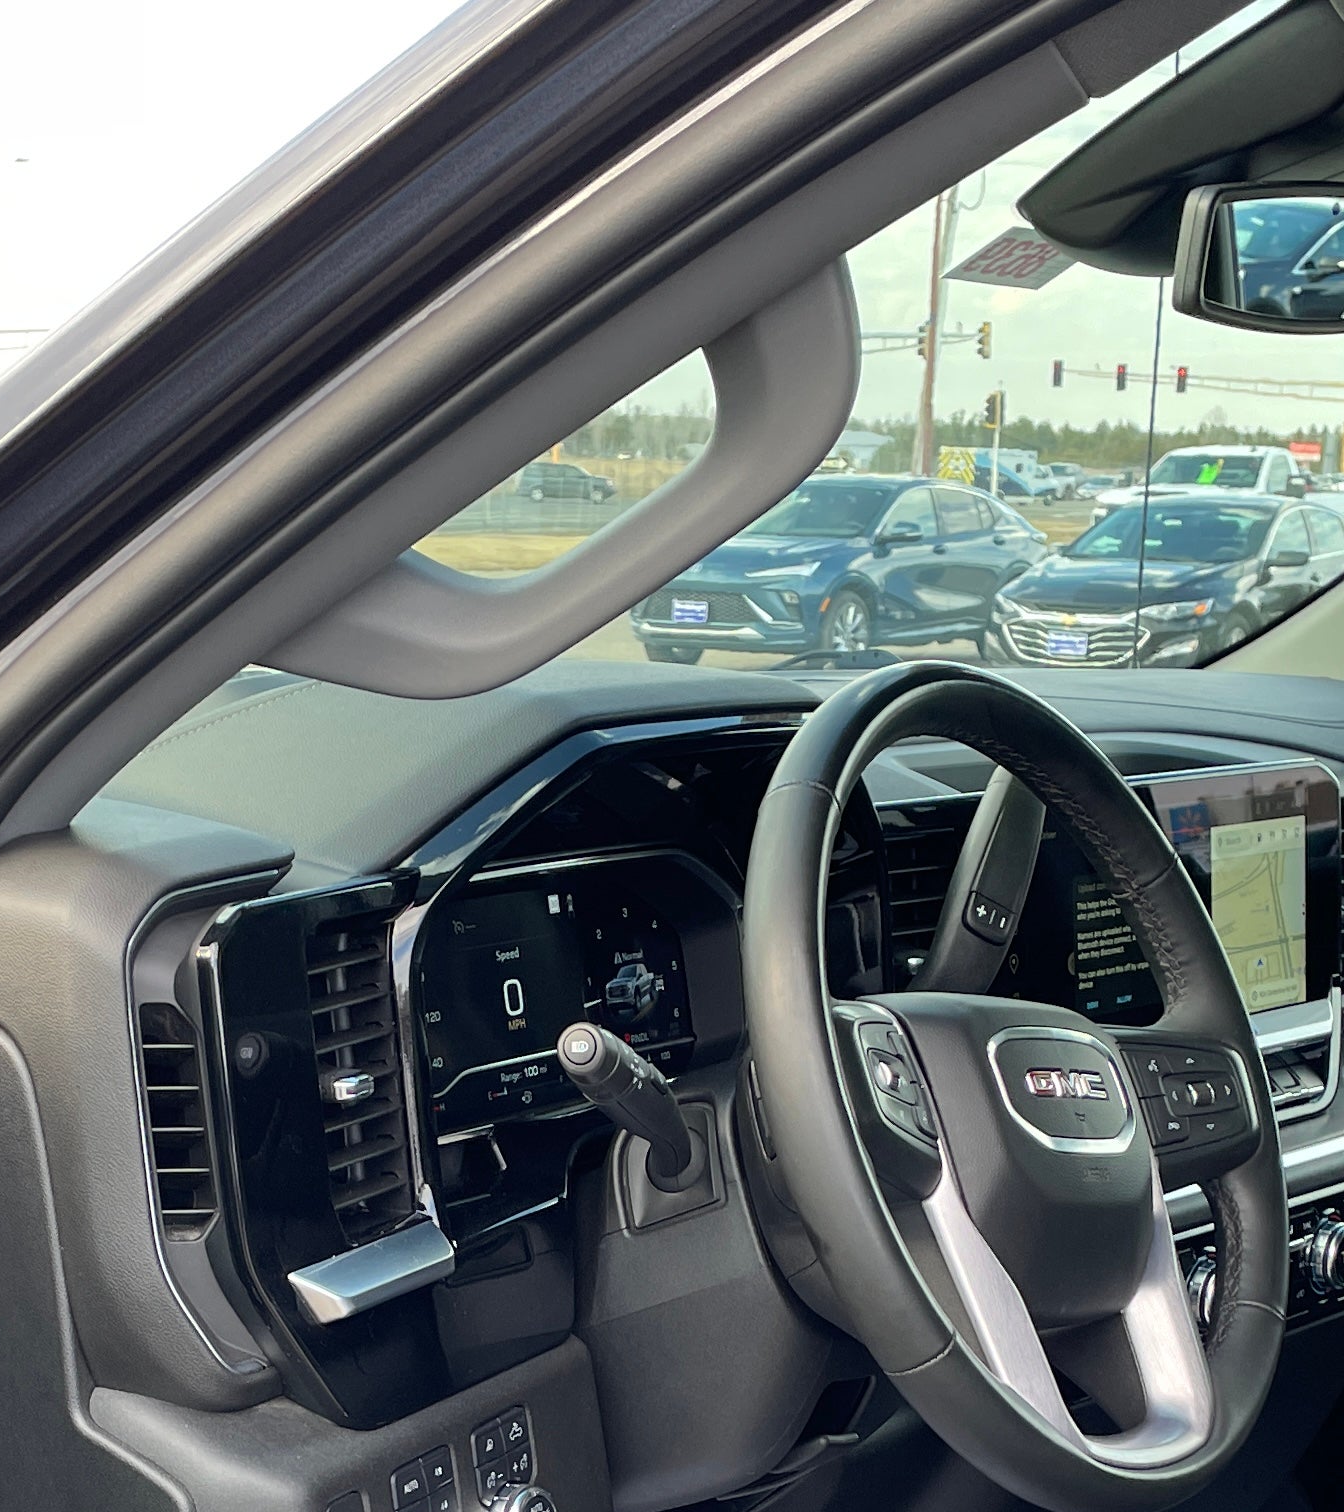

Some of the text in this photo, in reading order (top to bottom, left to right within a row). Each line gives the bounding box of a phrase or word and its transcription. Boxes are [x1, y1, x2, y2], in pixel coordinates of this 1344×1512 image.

[495, 946, 520, 963] Speed
[503, 978, 524, 1016] 0
[508, 1018, 526, 1031] MPH
[432, 1056, 444, 1068] 40
[524, 1065, 539, 1077] 100
[1025, 1066, 1109, 1101] GMC
